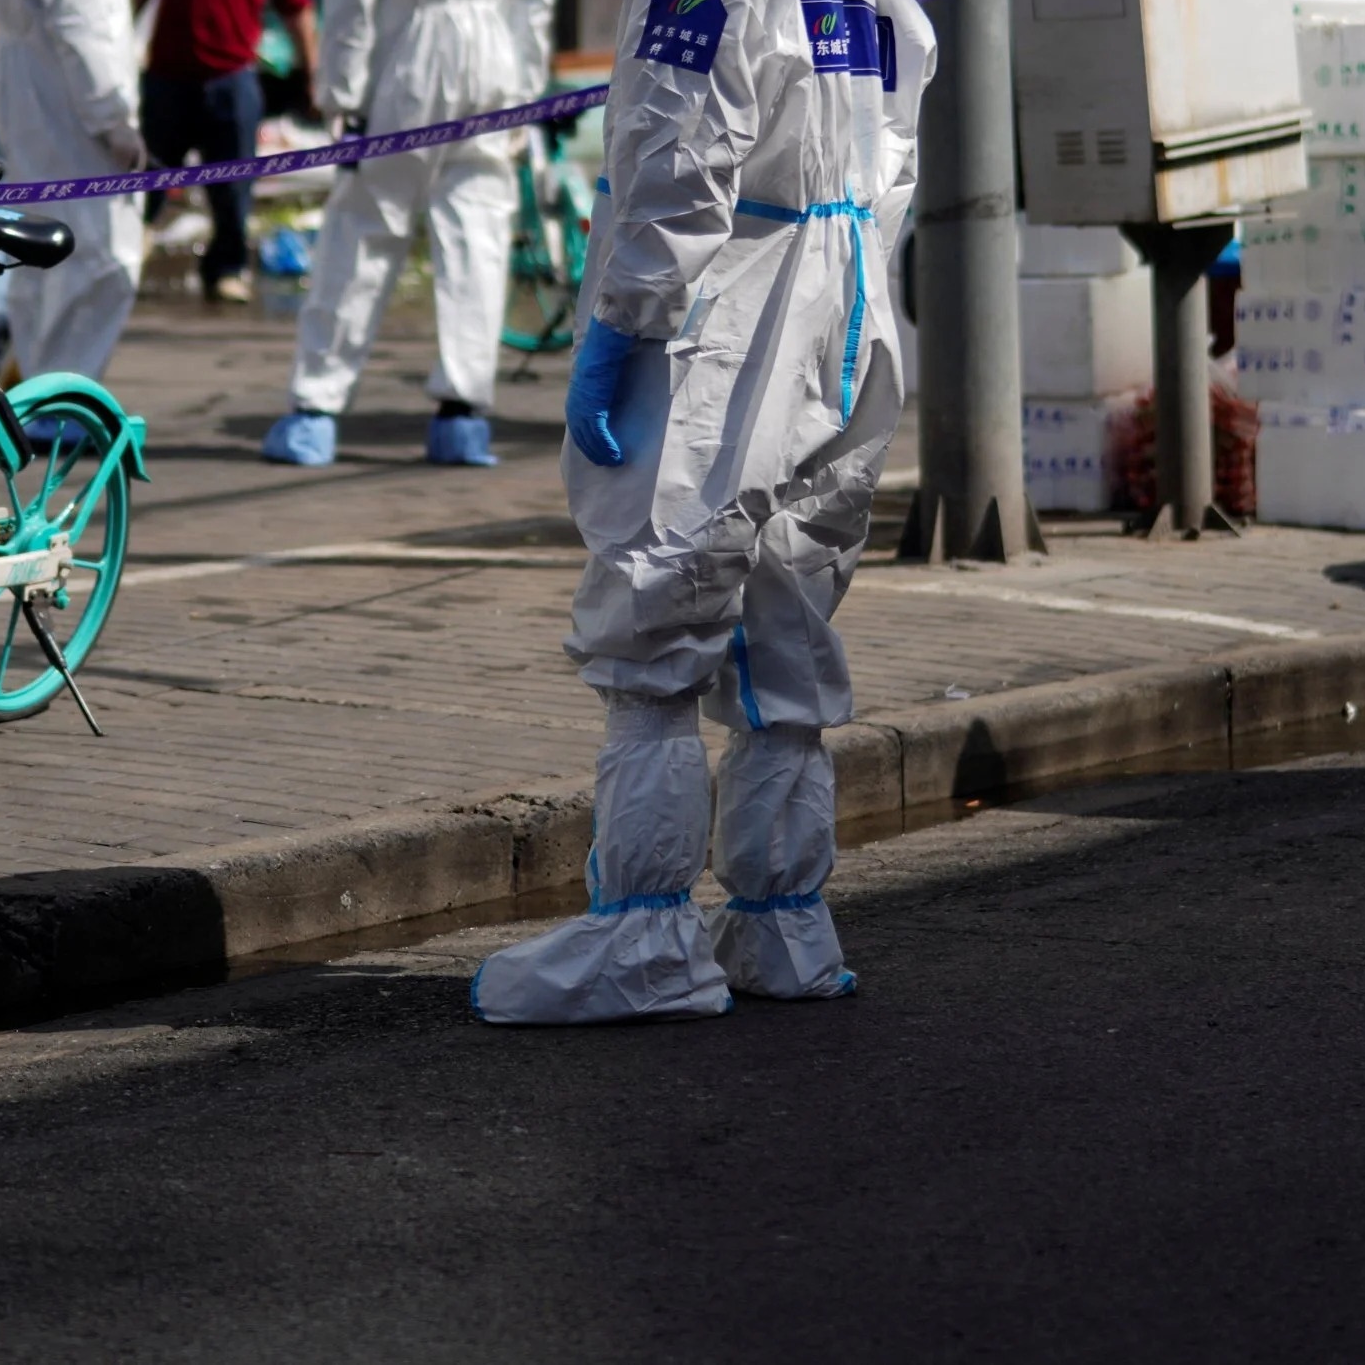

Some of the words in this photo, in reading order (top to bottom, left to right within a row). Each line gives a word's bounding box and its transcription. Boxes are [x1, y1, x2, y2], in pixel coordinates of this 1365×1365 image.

[651, 25, 708, 46] 南东城运
[83, 176, 149, 195] POLICE
[196, 162, 258, 182] POLICE
